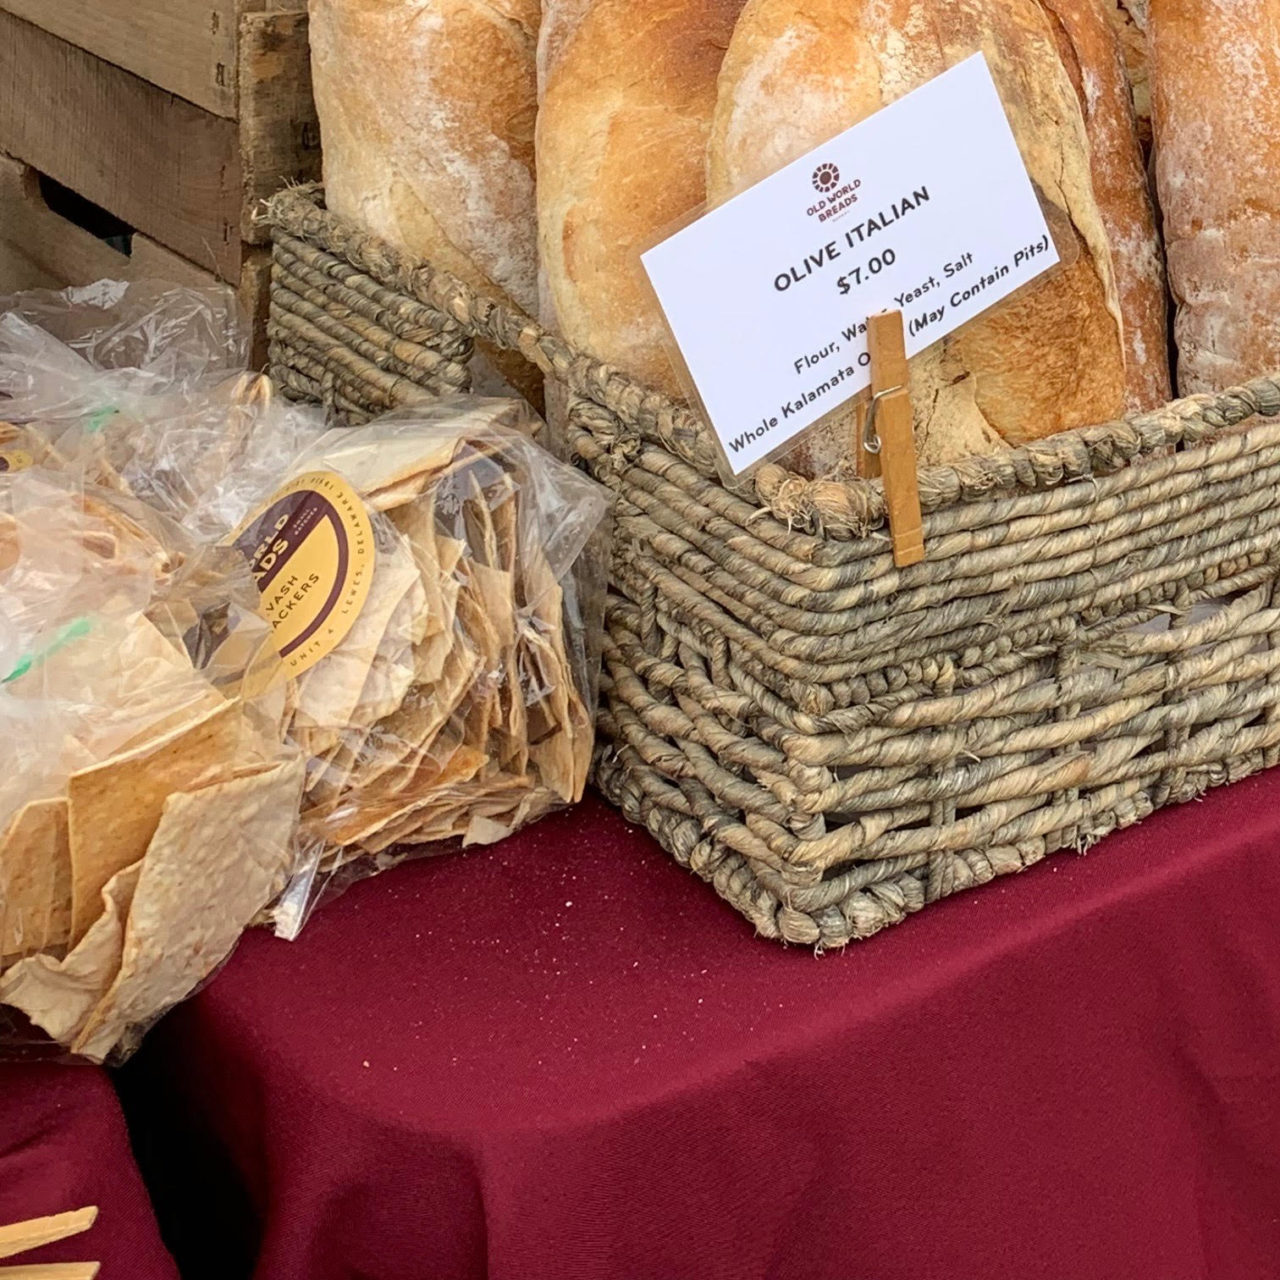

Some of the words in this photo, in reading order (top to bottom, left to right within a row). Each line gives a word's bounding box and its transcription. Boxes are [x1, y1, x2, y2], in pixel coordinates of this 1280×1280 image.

[806, 200, 827, 218] OLD
[827, 178, 862, 206] WORLD
[818, 194, 859, 223] BREADS
[773, 242, 841, 293] OLIVE
[845, 185, 931, 250] ITALIAN
[836, 248, 897, 295] $7.00
[729, 417, 779, 454] Whole
[781, 365, 855, 419] Kalamata
[908, 304, 946, 337] (May
[950, 265, 1011, 308] Contain
[1013, 235, 1050, 269] Pits)
[793, 339, 840, 375] Flour,
[894, 276, 941, 308] Yeast,
[943, 252, 974, 279] Salt
